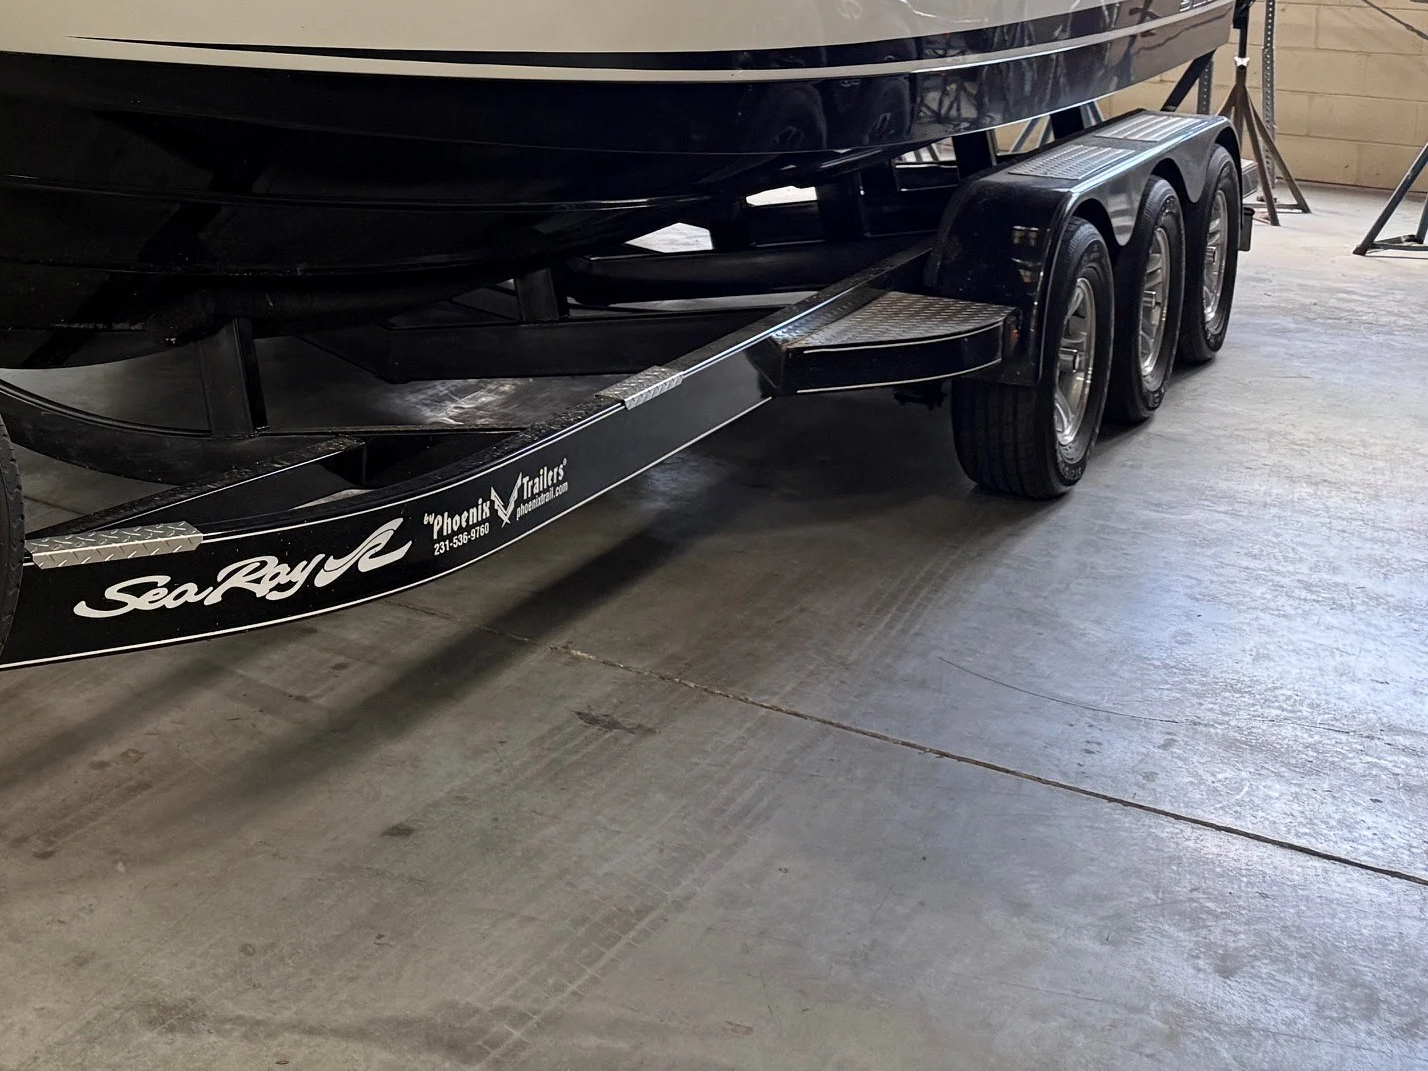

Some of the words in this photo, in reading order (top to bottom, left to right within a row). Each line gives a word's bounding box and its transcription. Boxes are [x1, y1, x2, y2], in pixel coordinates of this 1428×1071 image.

[423, 512, 434, 525] by
[433, 497, 491, 540] Phoenix
[522, 464, 565, 500] Trailers
[516, 481, 569, 521] phoenixtrail.com
[434, 522, 490, 556] 231-536-9760
